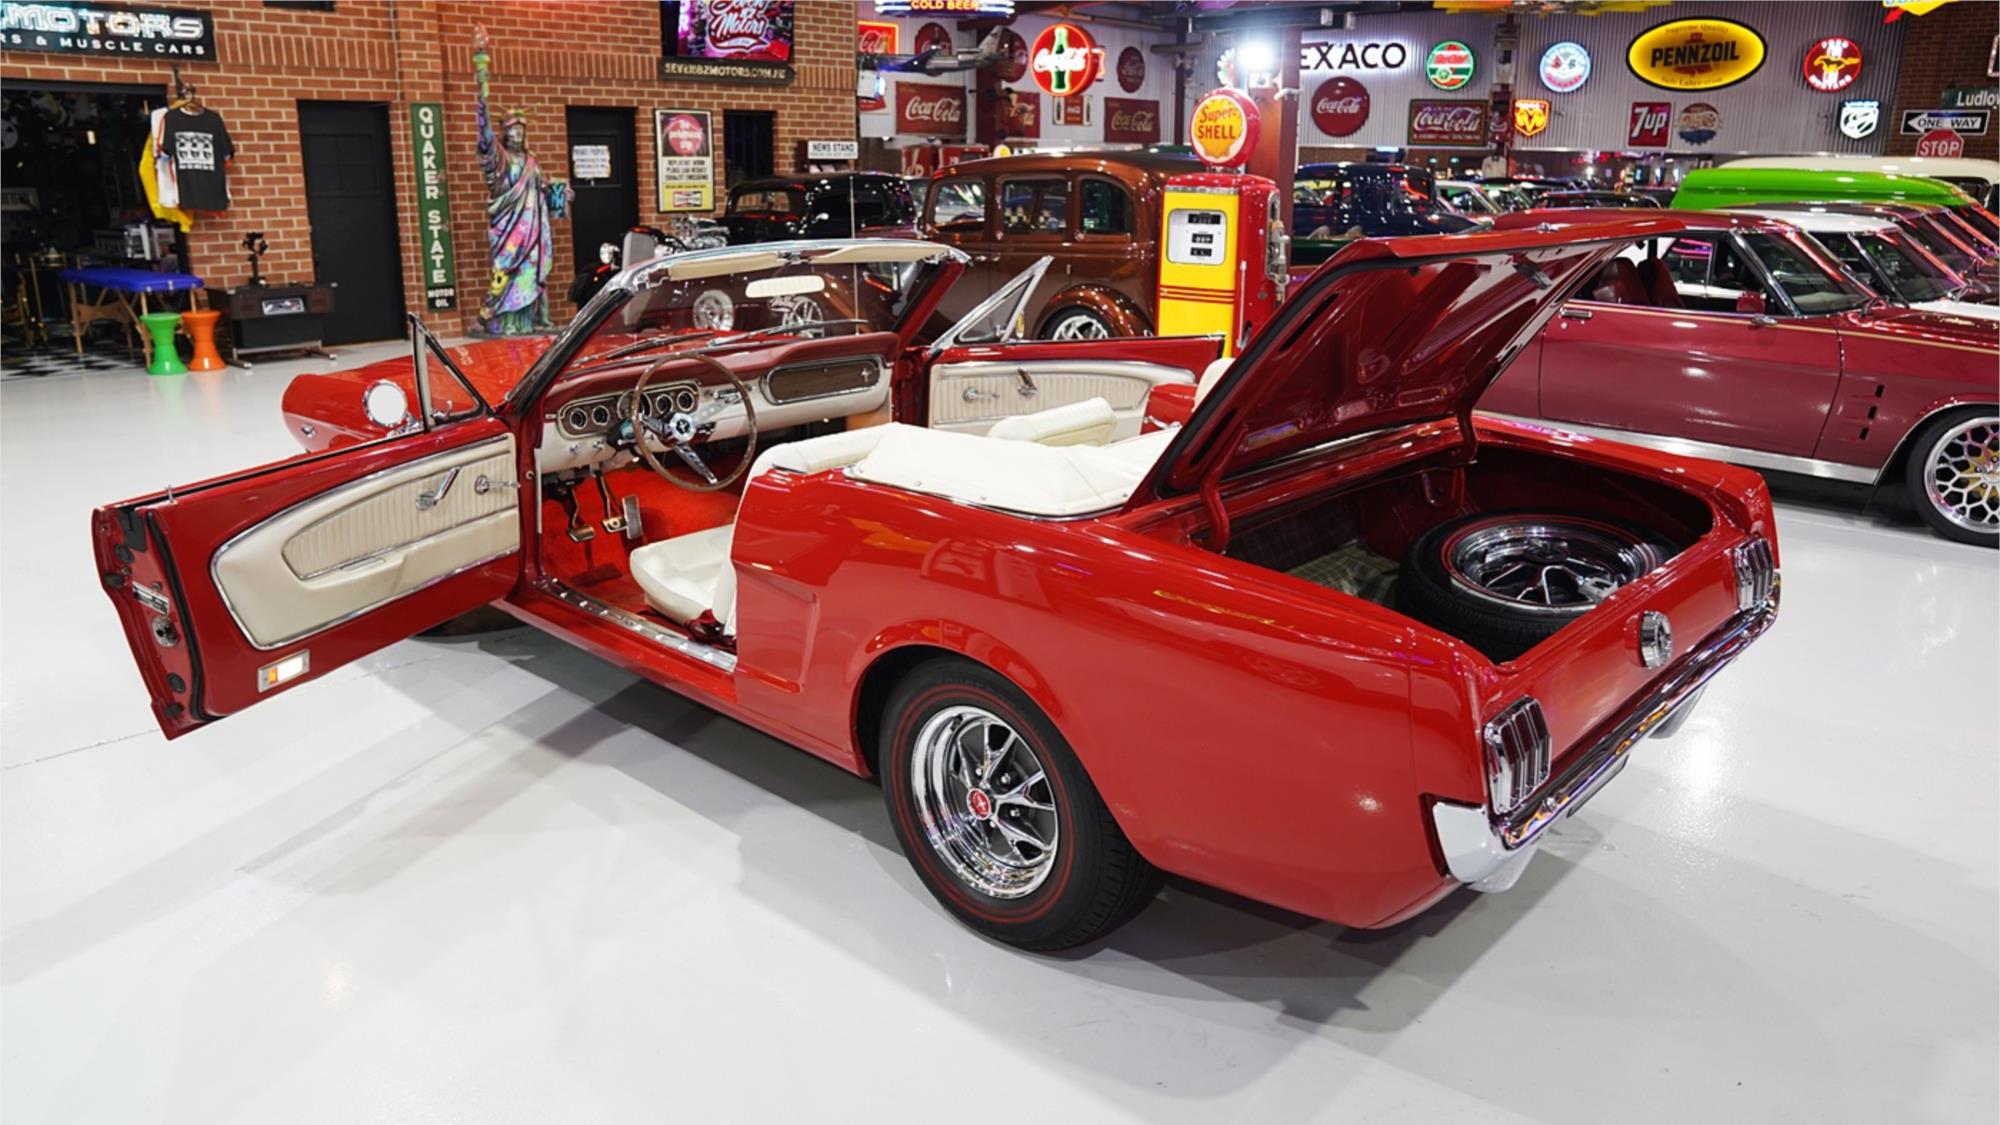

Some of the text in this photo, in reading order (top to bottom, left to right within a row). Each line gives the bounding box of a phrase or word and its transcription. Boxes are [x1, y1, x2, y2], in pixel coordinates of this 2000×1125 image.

[911, 0, 979, 10] COLD BEER
[1, 2, 205, 40] MOTORS
[711, 13, 764, 38] Motors
[36, 35, 48, 46] &
[60, 38, 144, 52] MUSCLE
[154, 43, 205, 55] CARS
[1650, 41, 1739, 68] PENNZOIL
[1300, 42, 1406, 70] EXACO
[905, 96, 961, 122] Coca-Cola
[1197, 124, 1236, 140] SHELL
[1917, 118, 1978, 128] ONE WAY
[418, 106, 440, 200] QUAKER
[812, 143, 854, 152] NEWS STAND
[1919, 140, 1960, 156] STOP
[427, 209, 447, 284] STATE
[428, 288, 454, 298] MOTOR
[435, 299, 449, 308] OIL
